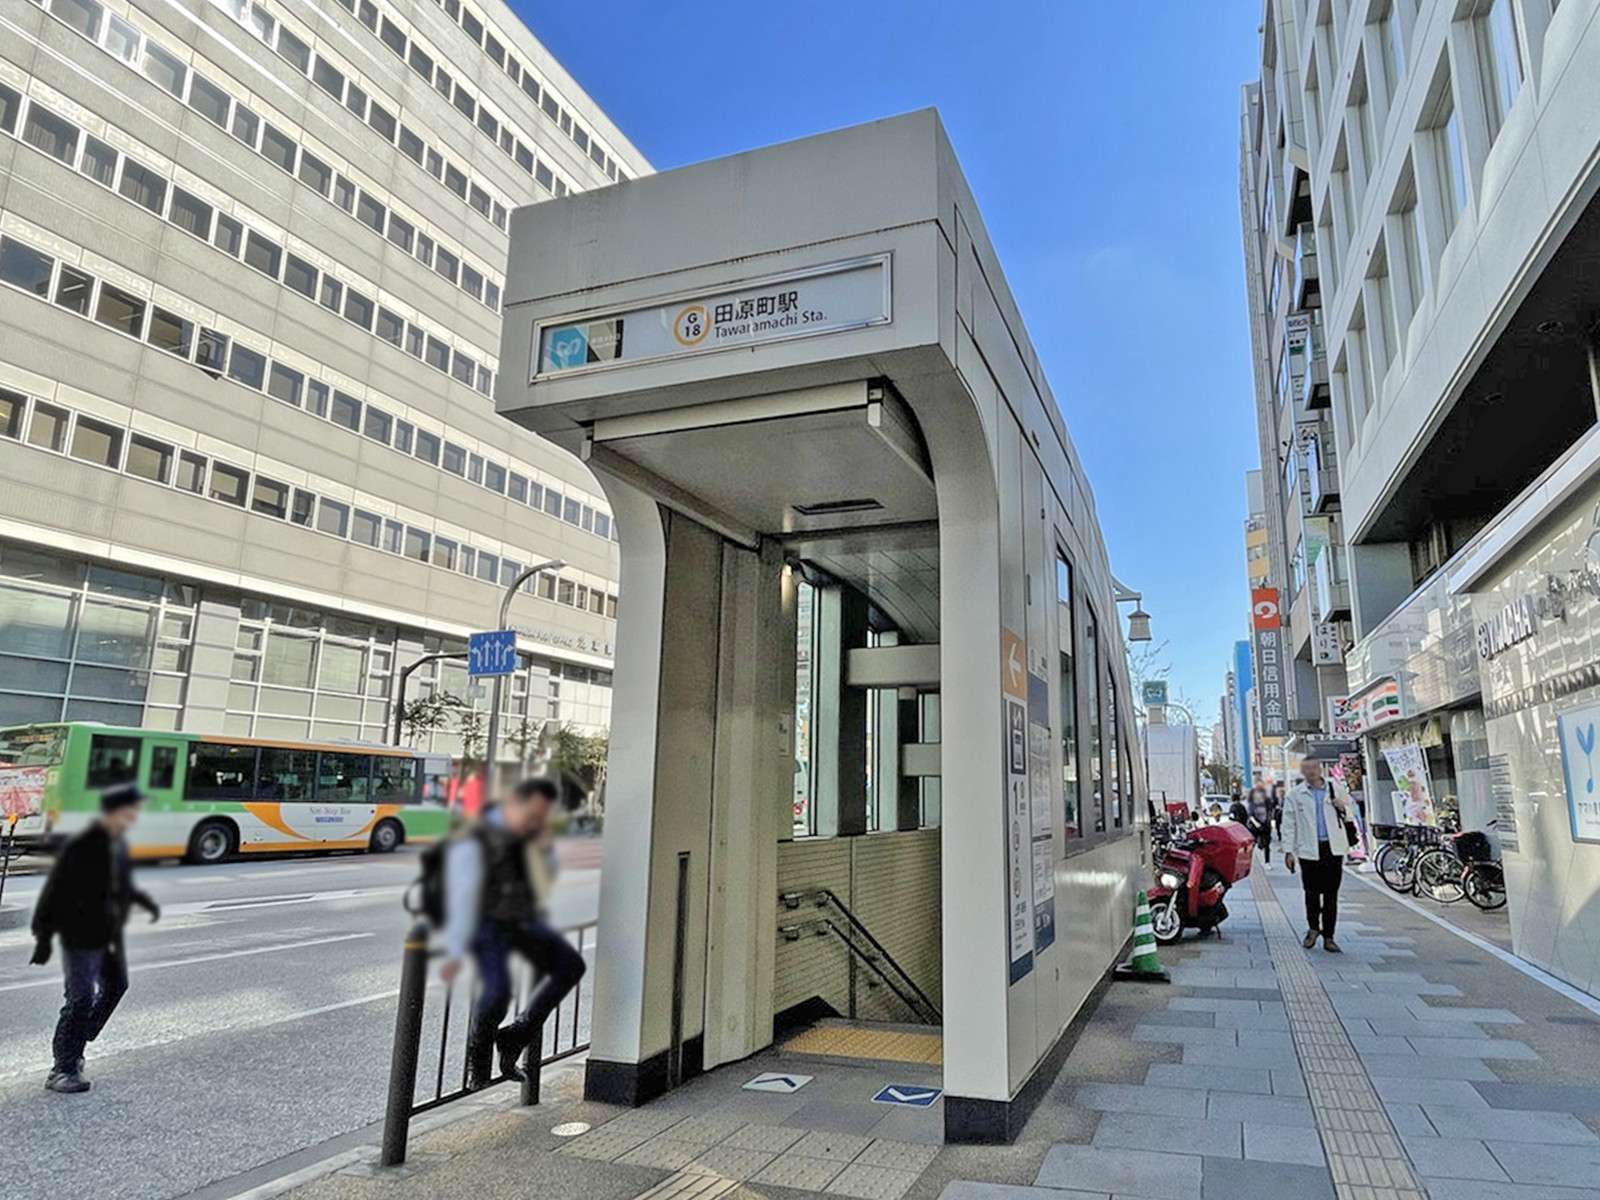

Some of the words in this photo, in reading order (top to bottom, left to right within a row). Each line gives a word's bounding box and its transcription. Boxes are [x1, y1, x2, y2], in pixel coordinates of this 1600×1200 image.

[687, 312, 698, 325] G
[714, 290, 799, 325] 田原町駅
[684, 324, 701, 337] 18
[714, 315, 798, 338] Tawaramachi
[802, 310, 827, 324] Sta.
[1260, 631, 1284, 733] 朝日信用金庫
